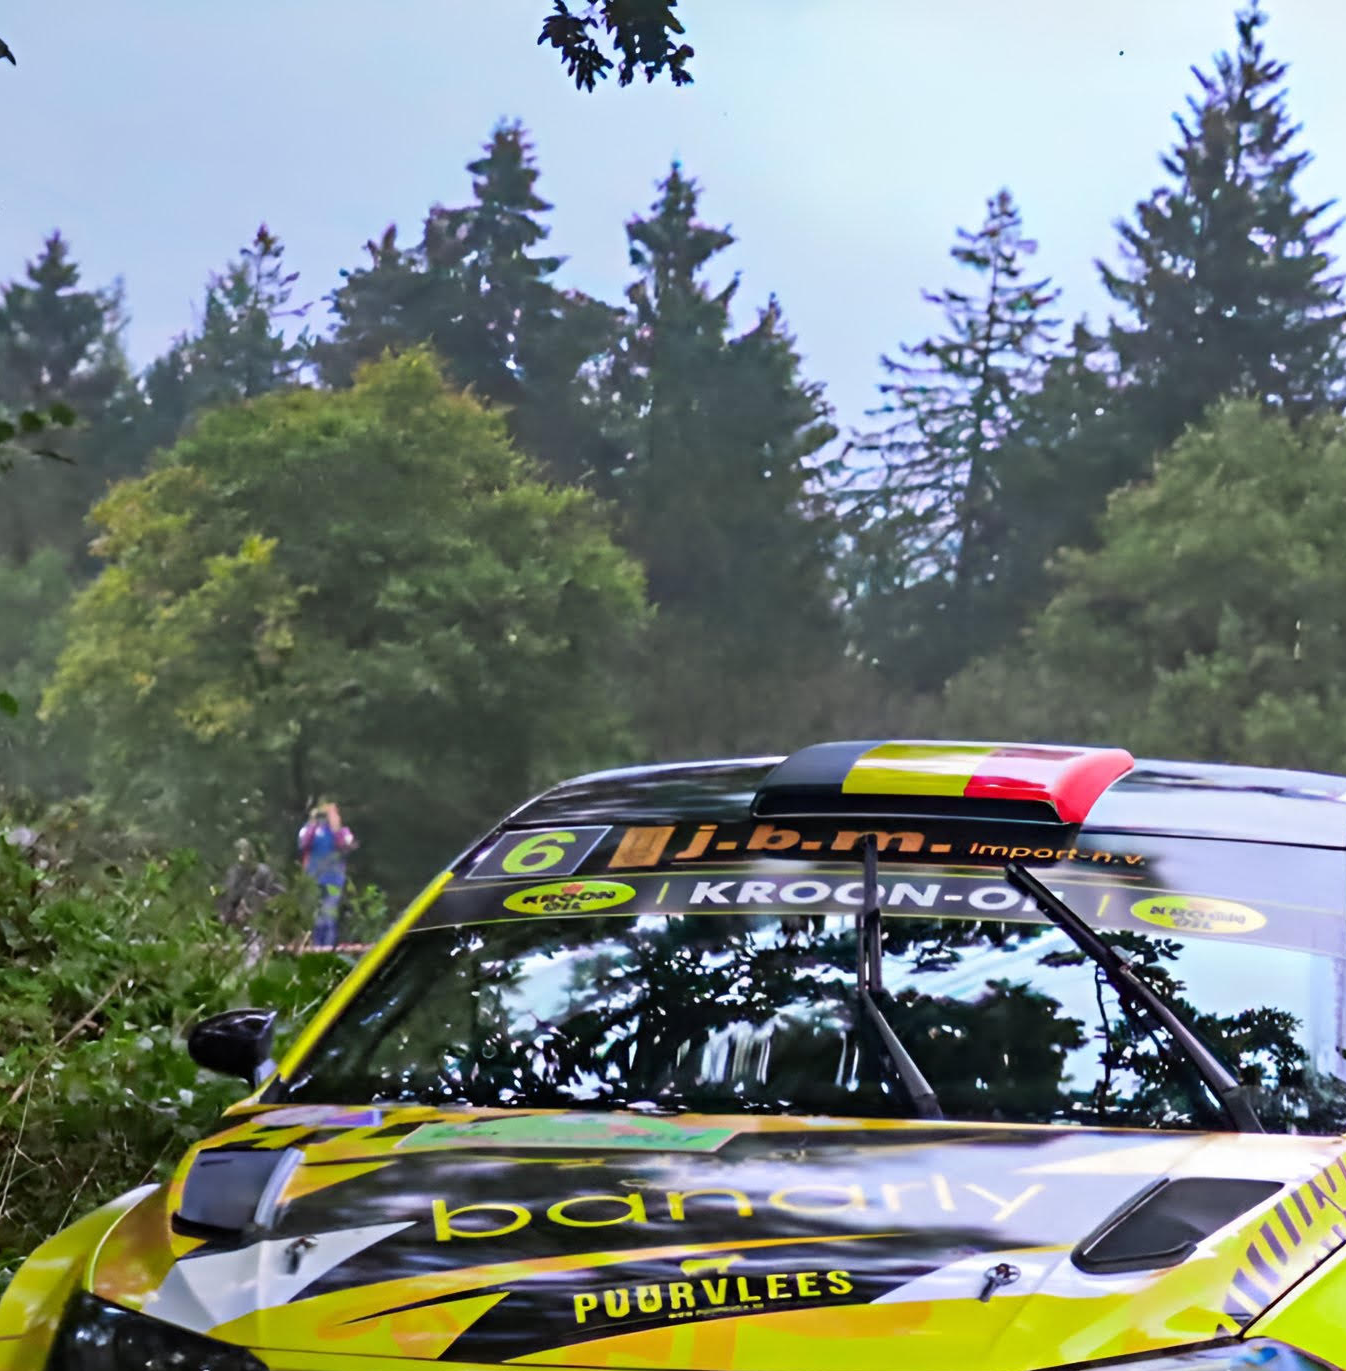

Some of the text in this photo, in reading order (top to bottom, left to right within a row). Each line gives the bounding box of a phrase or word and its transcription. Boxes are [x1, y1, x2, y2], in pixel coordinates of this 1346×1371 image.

[501, 831, 577, 874] 6
[688, 880, 1065, 913] KROON-O
[572, 1269, 854, 1324] PUURVLEES
